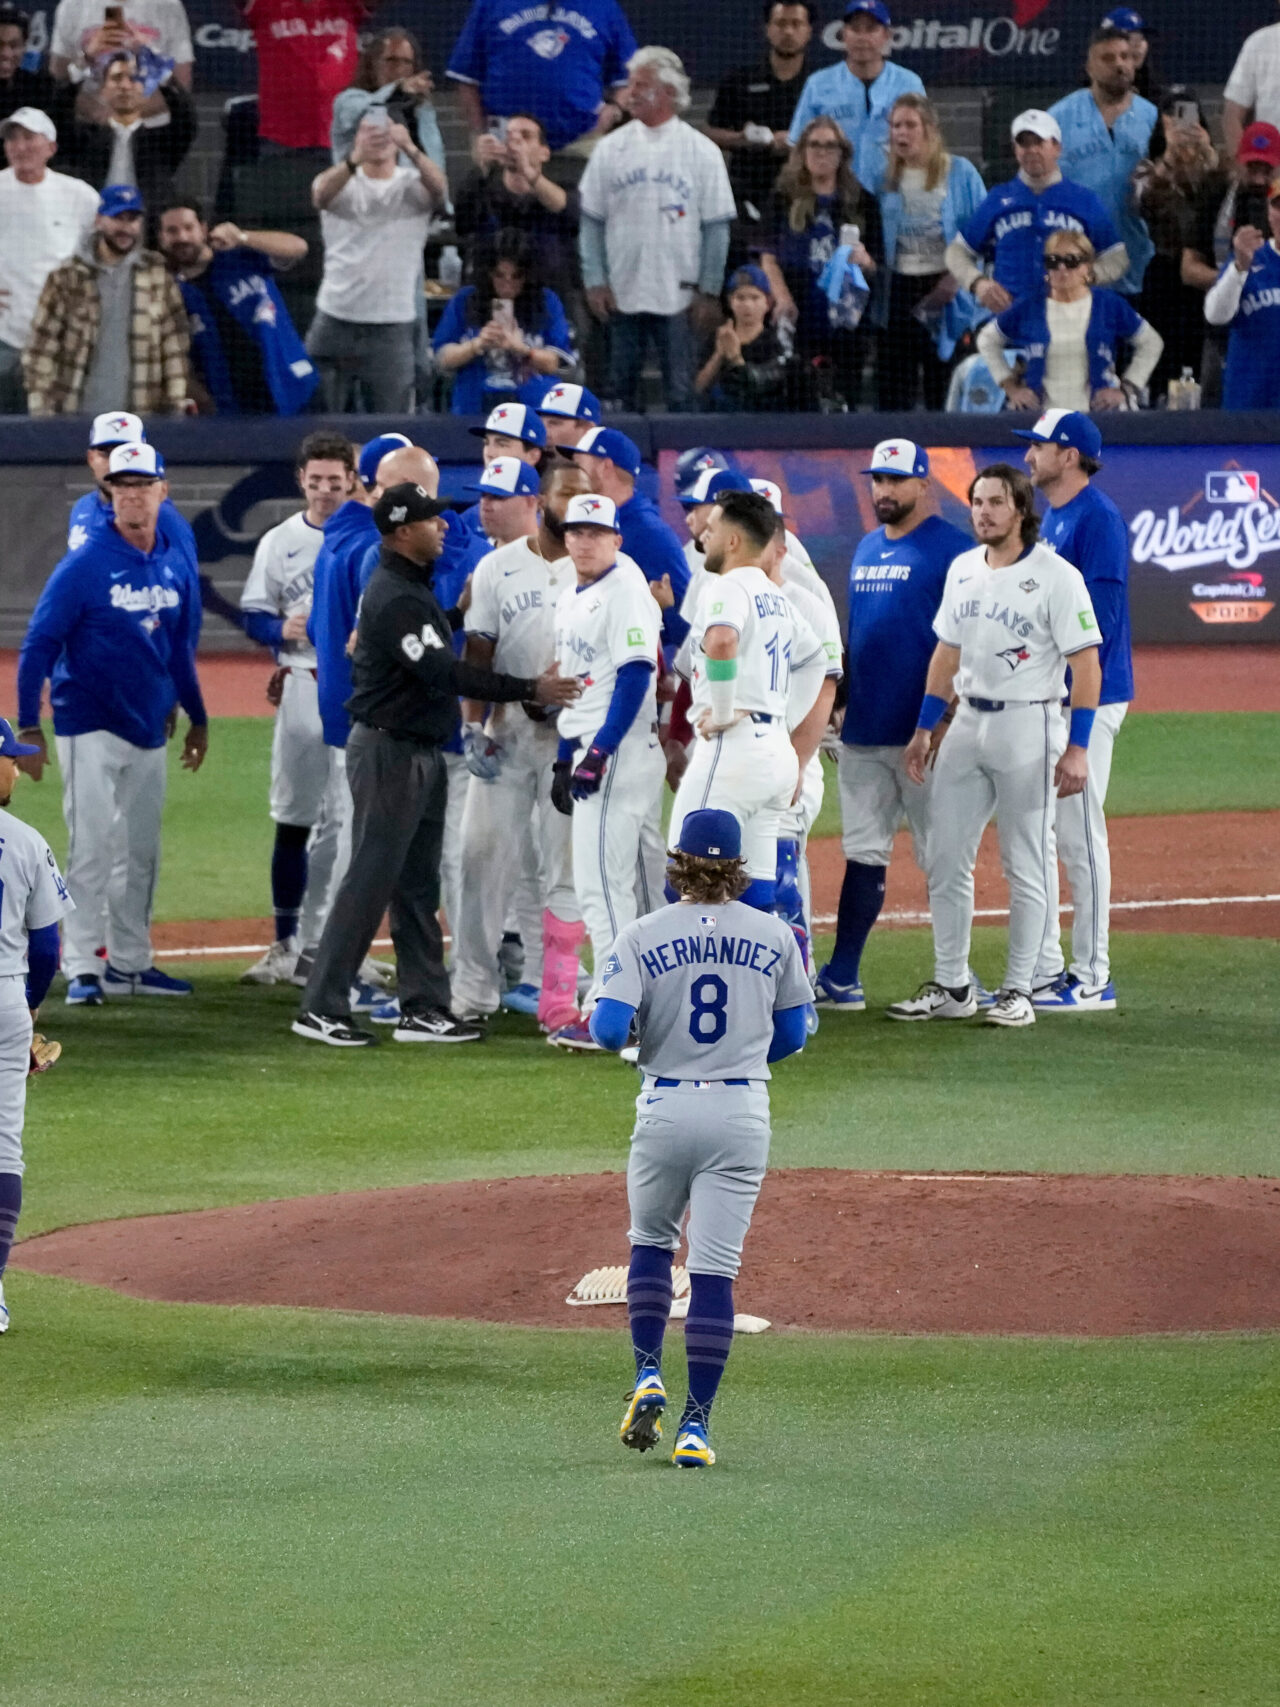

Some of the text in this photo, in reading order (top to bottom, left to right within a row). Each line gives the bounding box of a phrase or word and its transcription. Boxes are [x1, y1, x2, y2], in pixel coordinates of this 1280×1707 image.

[995, 210, 1032, 240] BLUE
[228, 275, 268, 305] JAY
[1130, 506, 1245, 565] World
[501, 591, 544, 625] BLUE
[952, 600, 1034, 638] LUE JAYS
[401, 623, 445, 662] 64
[764, 631, 792, 694] 11
[641, 931, 782, 979] HERNÁNDEZ
[689, 973, 728, 1044] 8
